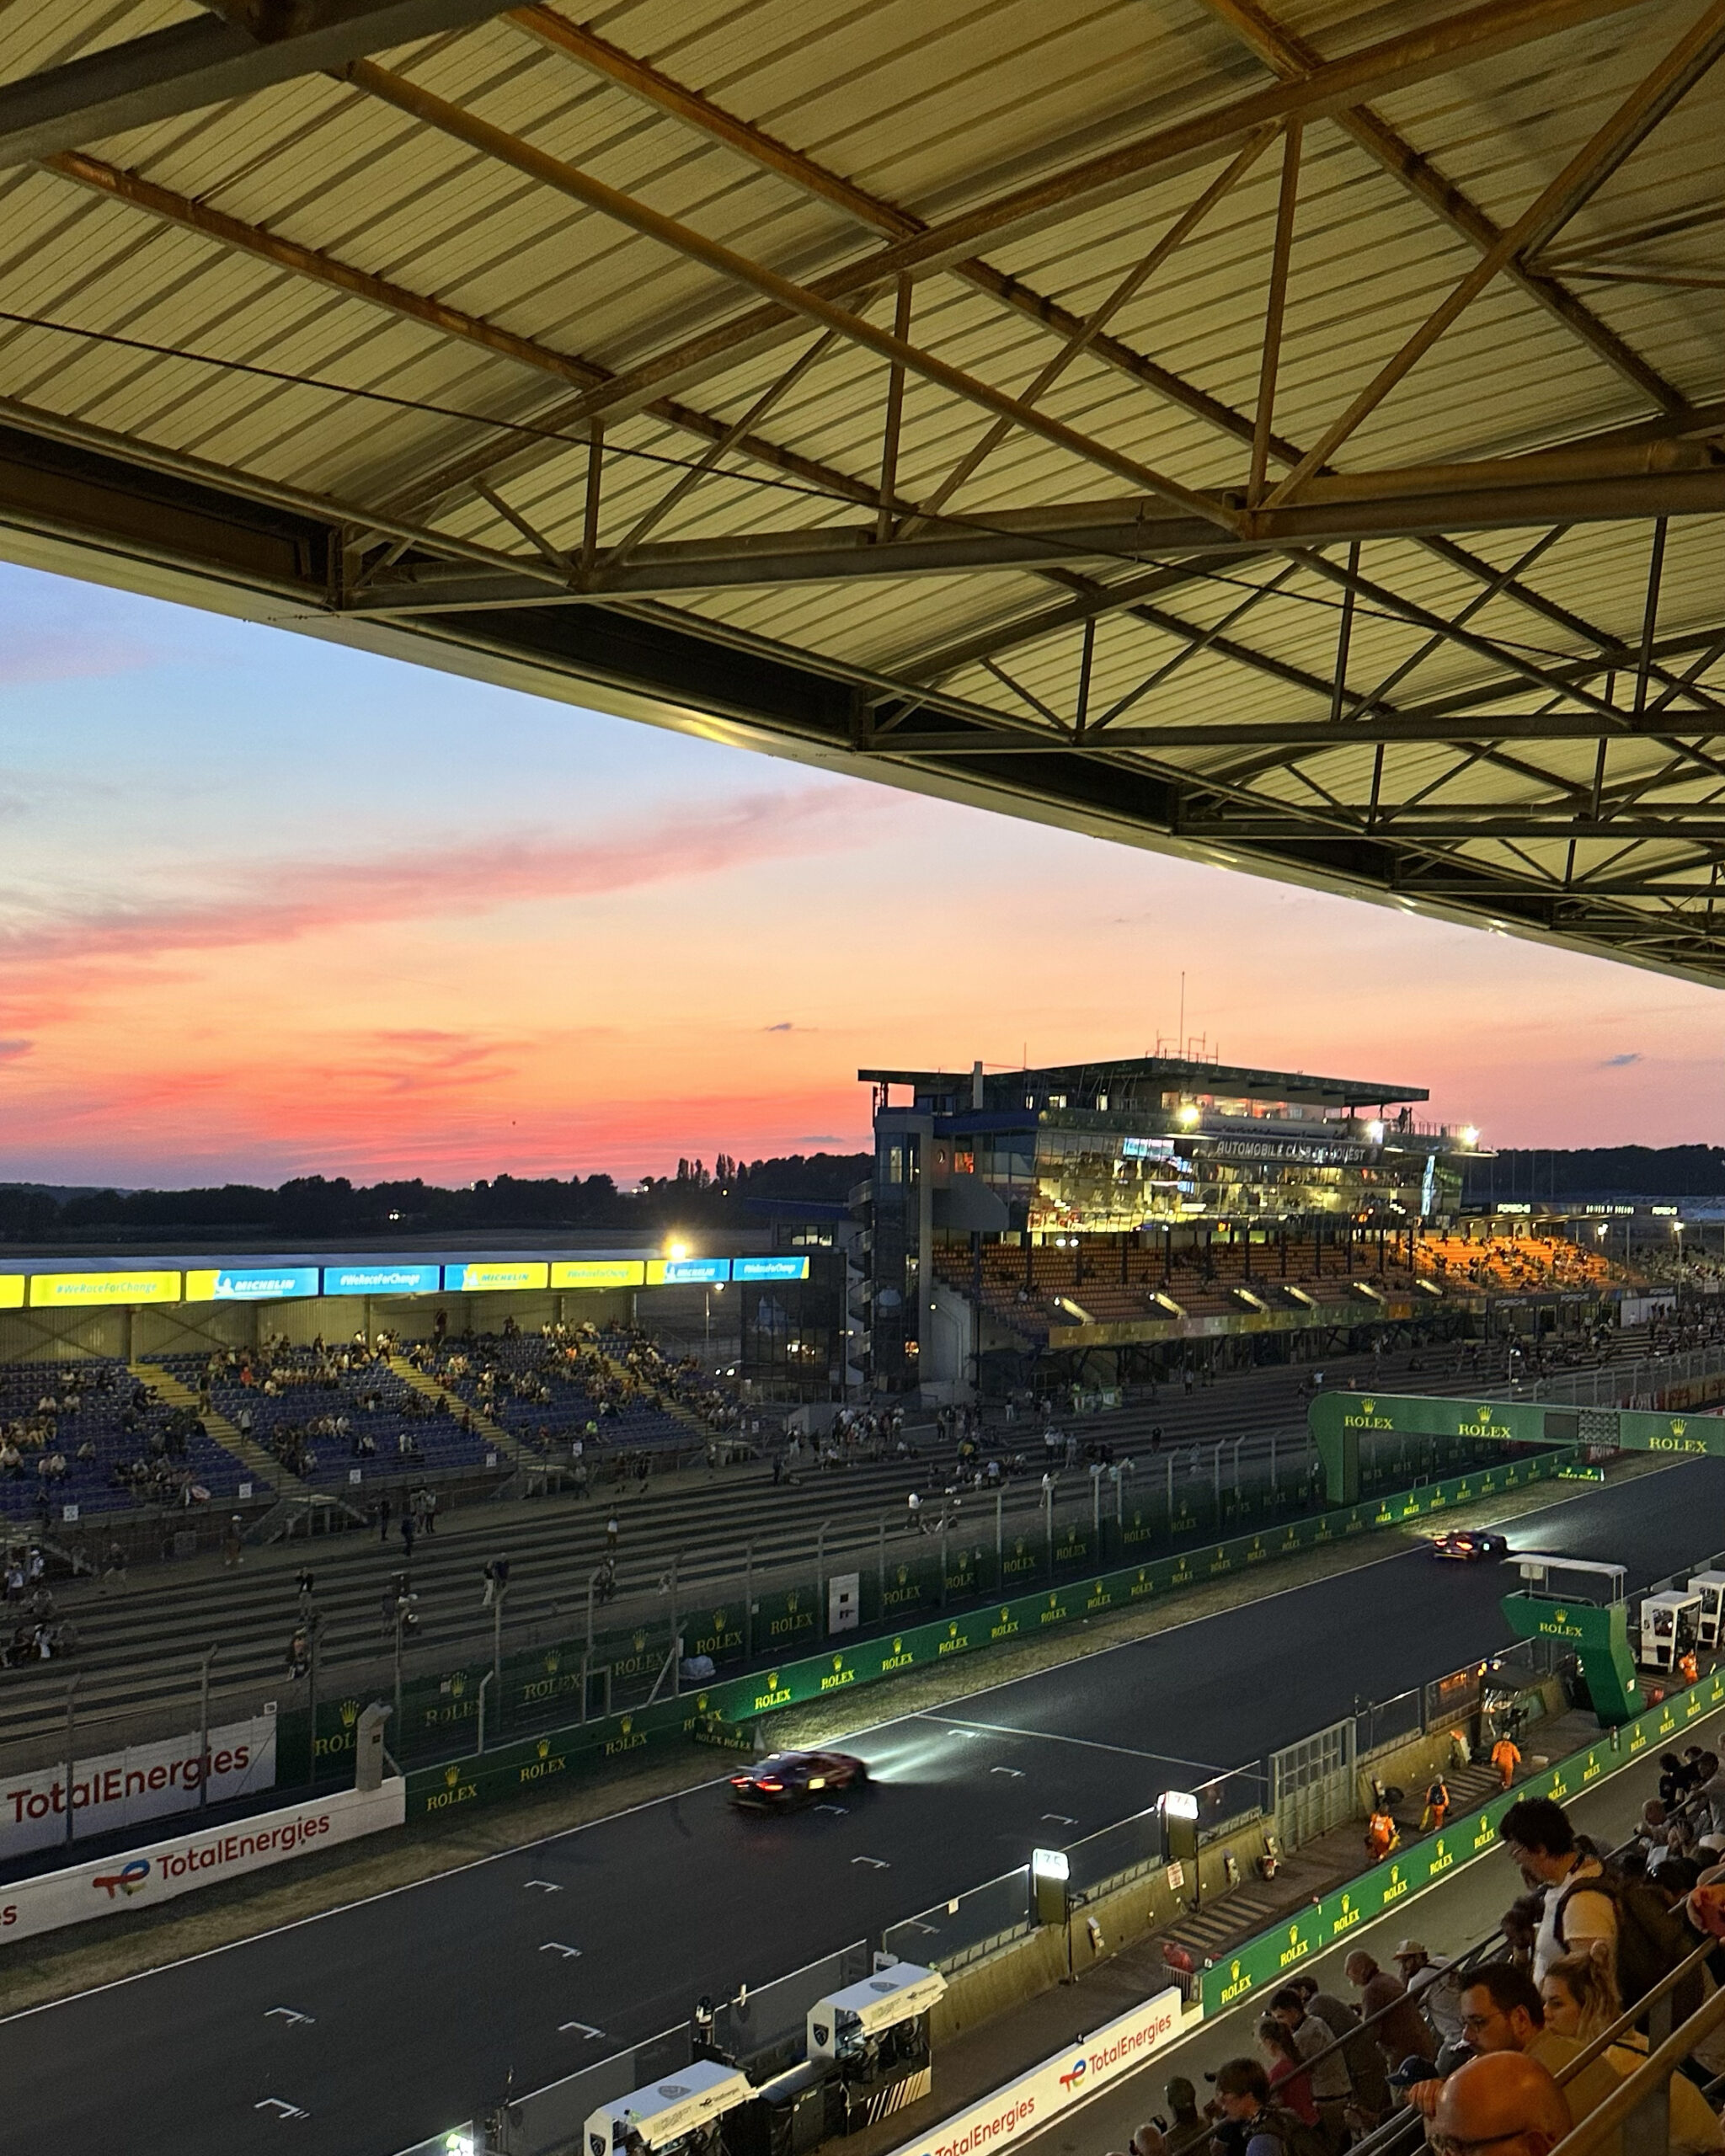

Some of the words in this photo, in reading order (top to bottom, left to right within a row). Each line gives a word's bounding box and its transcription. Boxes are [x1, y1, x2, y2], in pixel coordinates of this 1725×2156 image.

[1216, 1140, 1283, 1157] AUTOMOBILE
[234, 1279, 295, 1291] MICHELIN
[340, 1273, 420, 1286] #WeRaceForChange
[481, 1273, 529, 1282] MICHELIN
[56, 1282, 158, 1296] #WeRaceForChange
[1344, 1415, 1395, 1430] ROLEX
[1458, 1423, 1512, 1438] ROLEX
[1648, 1437, 1708, 1454] ROLEX
[1124, 1527, 1152, 1544] ROLEX
[1056, 1543, 1087, 1560] ROLEX
[1004, 1556, 1036, 1574] ROLEX
[1172, 1570, 1194, 1584] ROLEX
[884, 1585, 921, 1605] ROLEX
[1130, 1582, 1154, 1597] ROLEX
[1087, 1593, 1112, 1609] ROLEX
[770, 1612, 814, 1636] ROLEX
[1040, 1606, 1067, 1623] ROLEX
[991, 1620, 1019, 1639] ROLEX
[1539, 1622, 1583, 1637] ROLEX
[697, 1630, 743, 1655] ROLEX
[939, 1636, 969, 1655] ROLEX
[615, 1651, 665, 1677] ROLEX
[882, 1652, 914, 1672] ROLEX
[524, 1673, 584, 1700] ROLEX
[821, 1669, 855, 1690] ROLEX
[754, 1688, 792, 1710] ROLEX
[1659, 1718, 1675, 1735] ROLEX
[314, 1732, 356, 1758] ROL
[605, 1731, 649, 1757] ROLEX
[696, 1732, 722, 1744] ROLEX
[1630, 1735, 1647, 1753] ROLEX
[520, 1755, 567, 1783] ROLEX
[1583, 1764, 1600, 1781] ROLEX
[7, 1744, 250, 1823] TotalEnergies
[426, 1783, 478, 1812] ROLEX
[157, 1815, 330, 1881] TotalEnergies
[1474, 1828, 1495, 1849] ROLEX
[1429, 1852, 1454, 1876] ROLEX
[1383, 1878, 1407, 1903] ROLEX
[1333, 1907, 1360, 1935] ROLEX
[1280, 1940, 1309, 1968] ROLEX
[1221, 1973, 1252, 2004] ROLEX
[1089, 2014, 1172, 2075] TotalEnergies
[935, 2096, 1035, 2156] TotalEnergies
